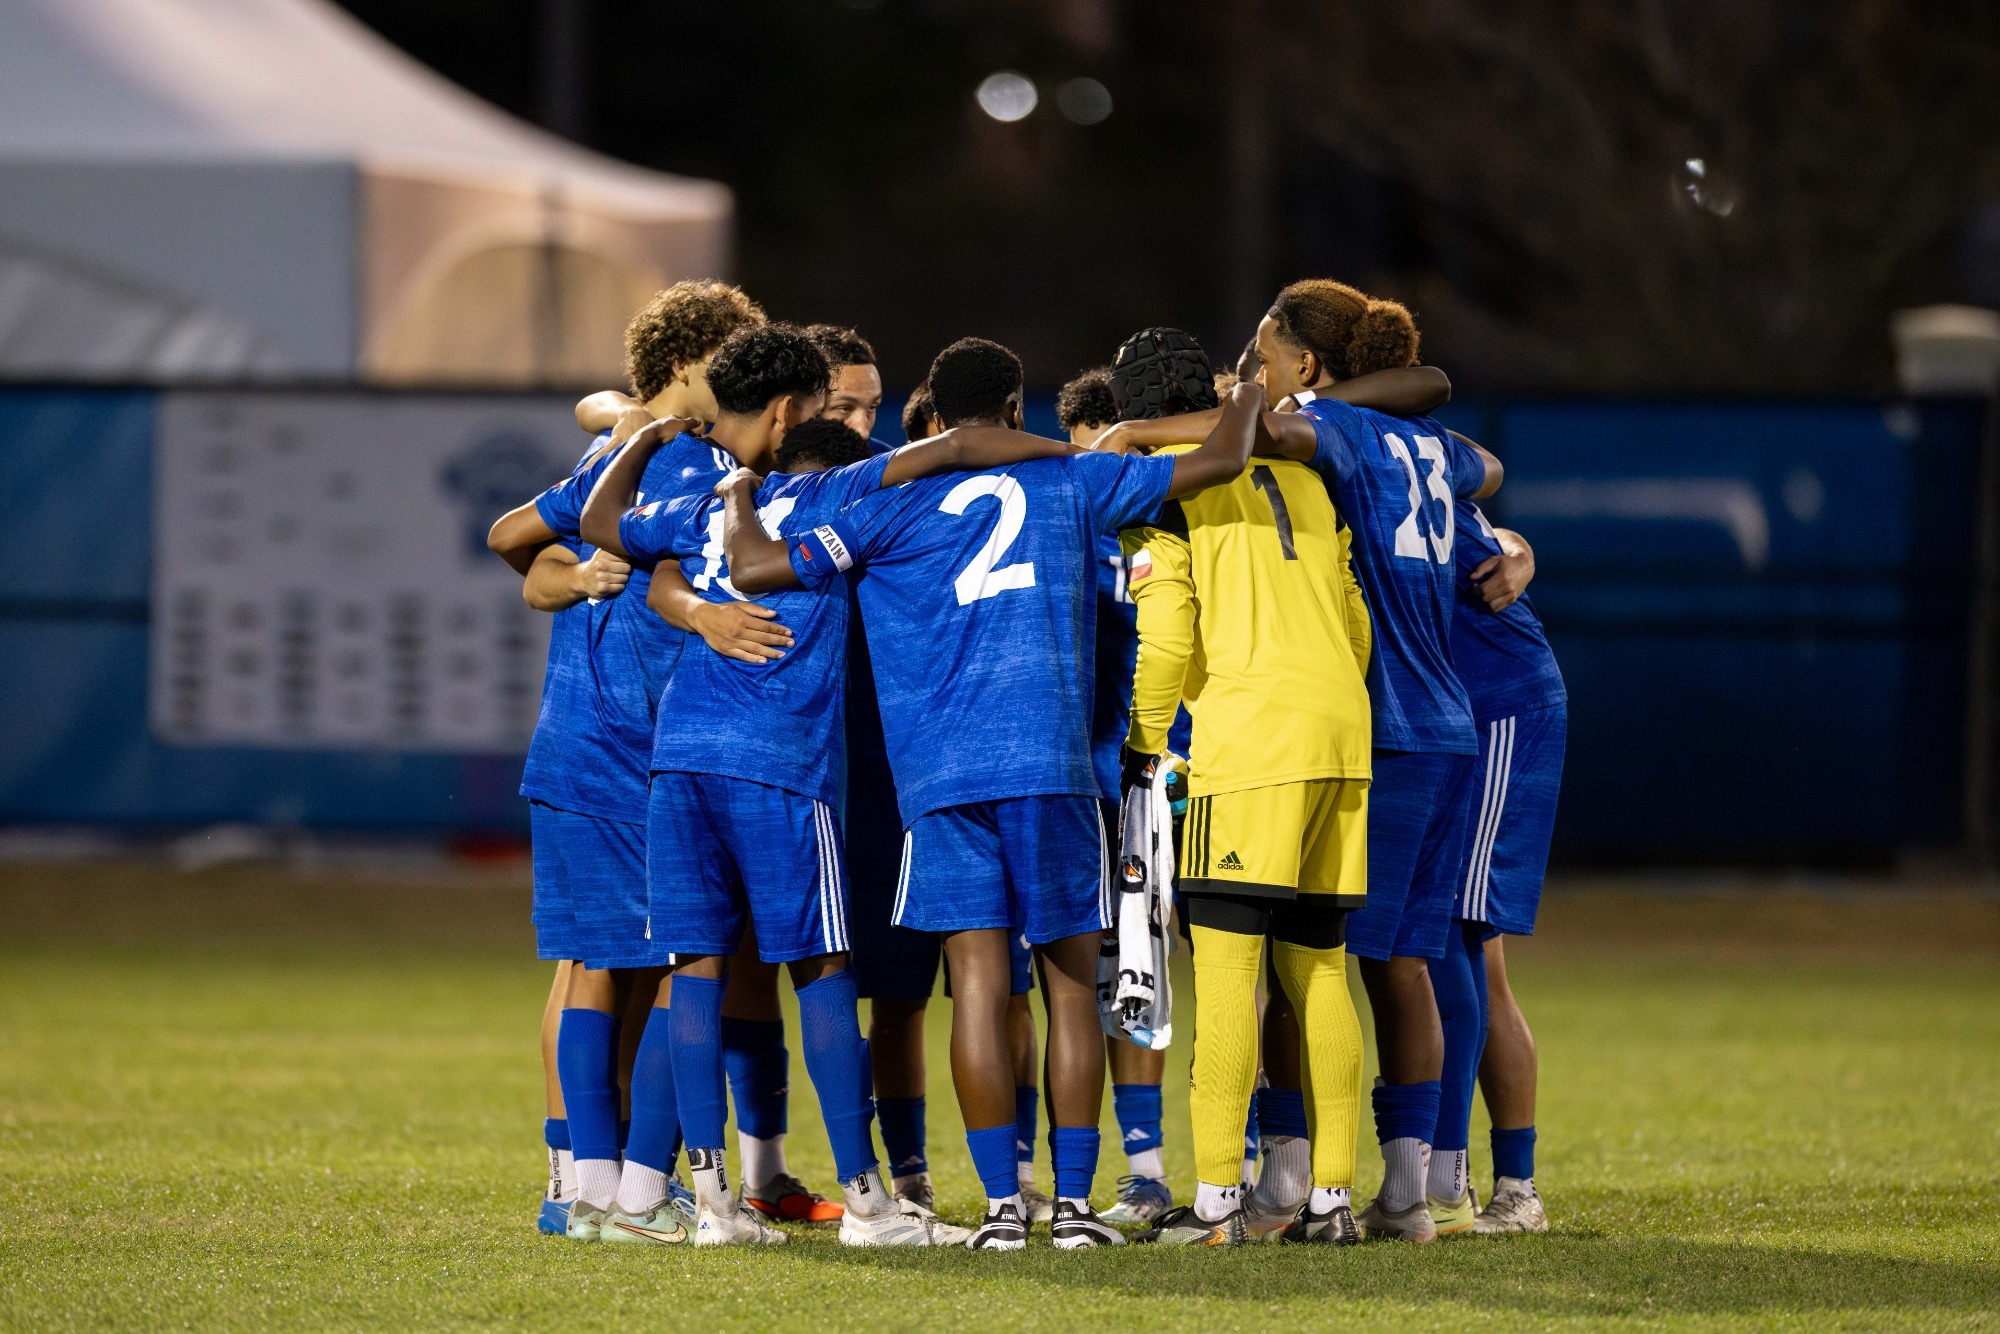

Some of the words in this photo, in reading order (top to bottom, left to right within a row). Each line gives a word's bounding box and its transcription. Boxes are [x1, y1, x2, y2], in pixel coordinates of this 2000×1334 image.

[1250, 465, 1298, 560] 1
[1384, 433, 1454, 564] 23
[818, 526, 845, 560] PTAIN
[938, 473, 1036, 606] 2
[1454, 1152, 1463, 1191] SOCKS
[1057, 1211, 1073, 1219] KING
